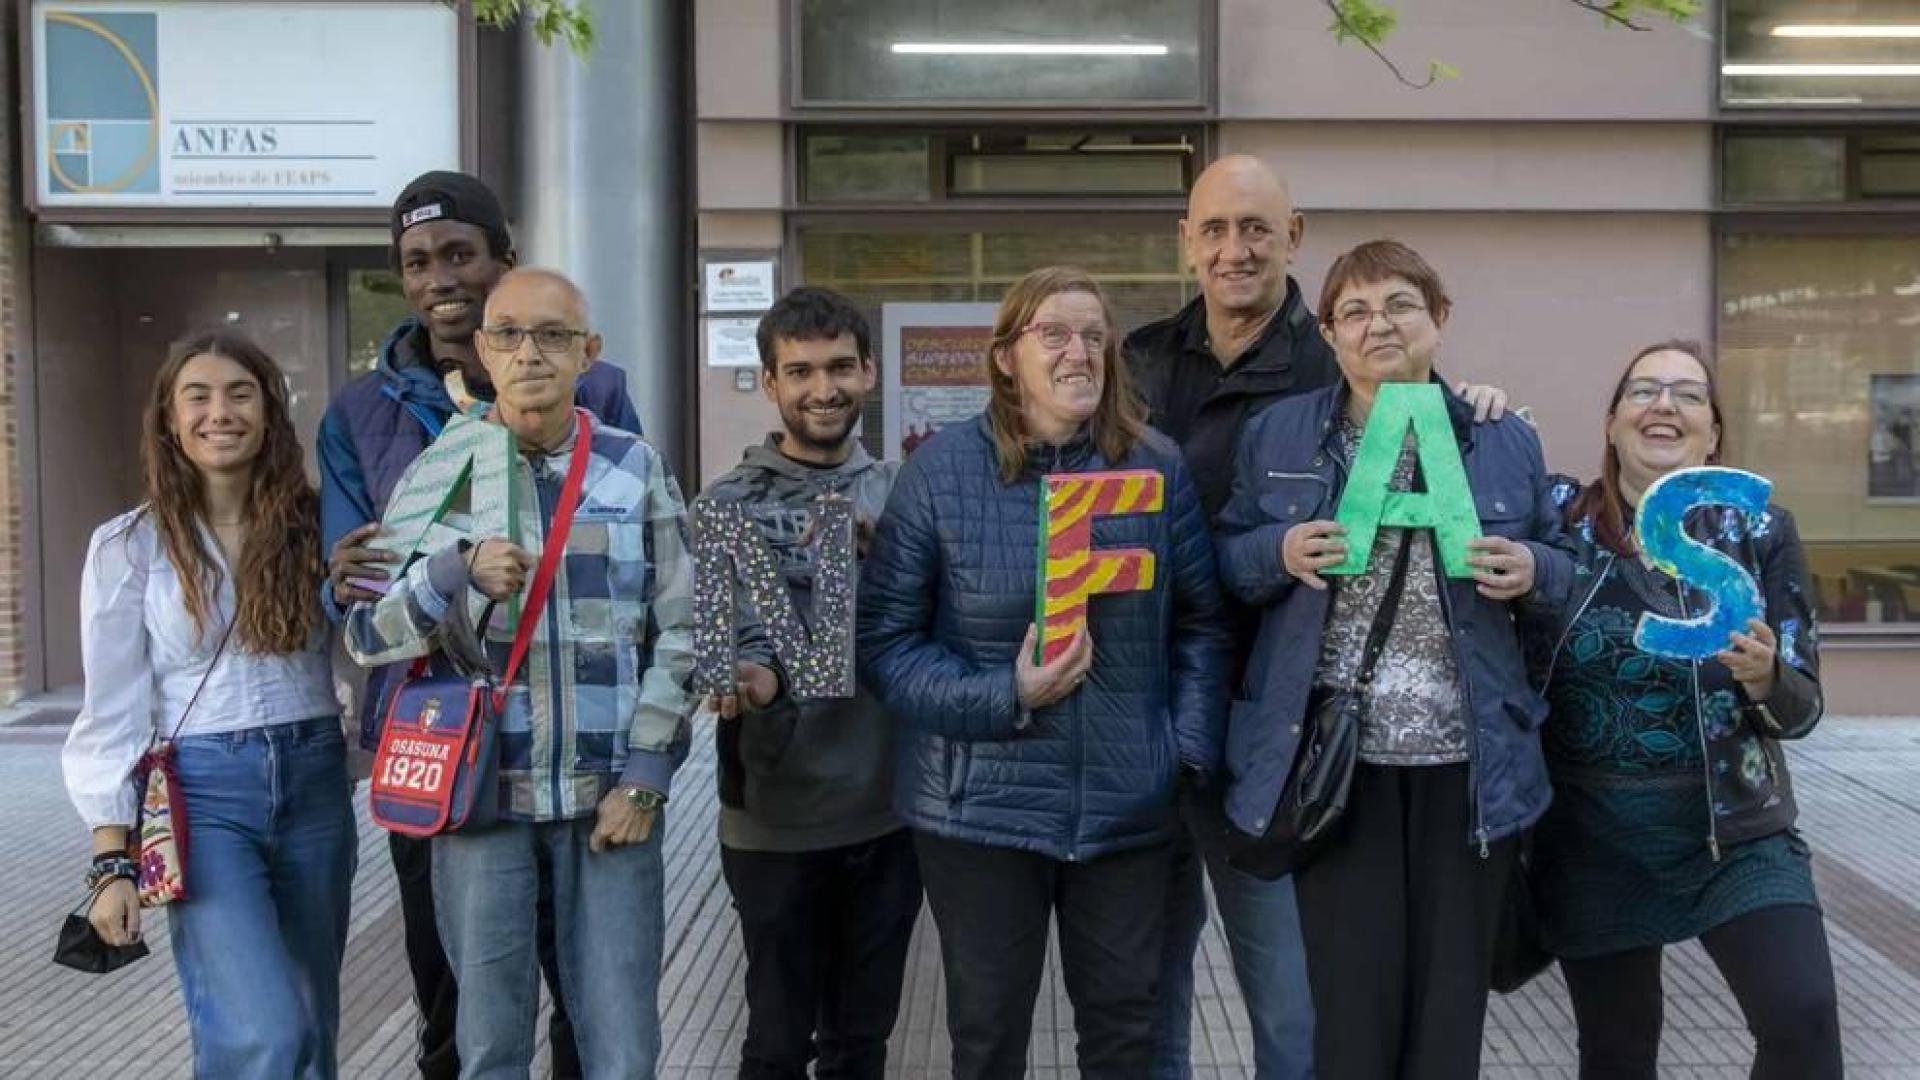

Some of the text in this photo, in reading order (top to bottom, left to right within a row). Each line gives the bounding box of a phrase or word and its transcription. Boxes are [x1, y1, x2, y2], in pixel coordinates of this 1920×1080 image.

[173, 126, 278, 153] ANFAS
[251, 168, 266, 185] de
[347, 411, 522, 634] A
[1036, 469, 1164, 669] F
[1316, 383, 1485, 580] A
[1633, 465, 1774, 662] S
[692, 497, 857, 699] N
[380, 755, 443, 792] 1920
[390, 738, 450, 761] OSASUNA
